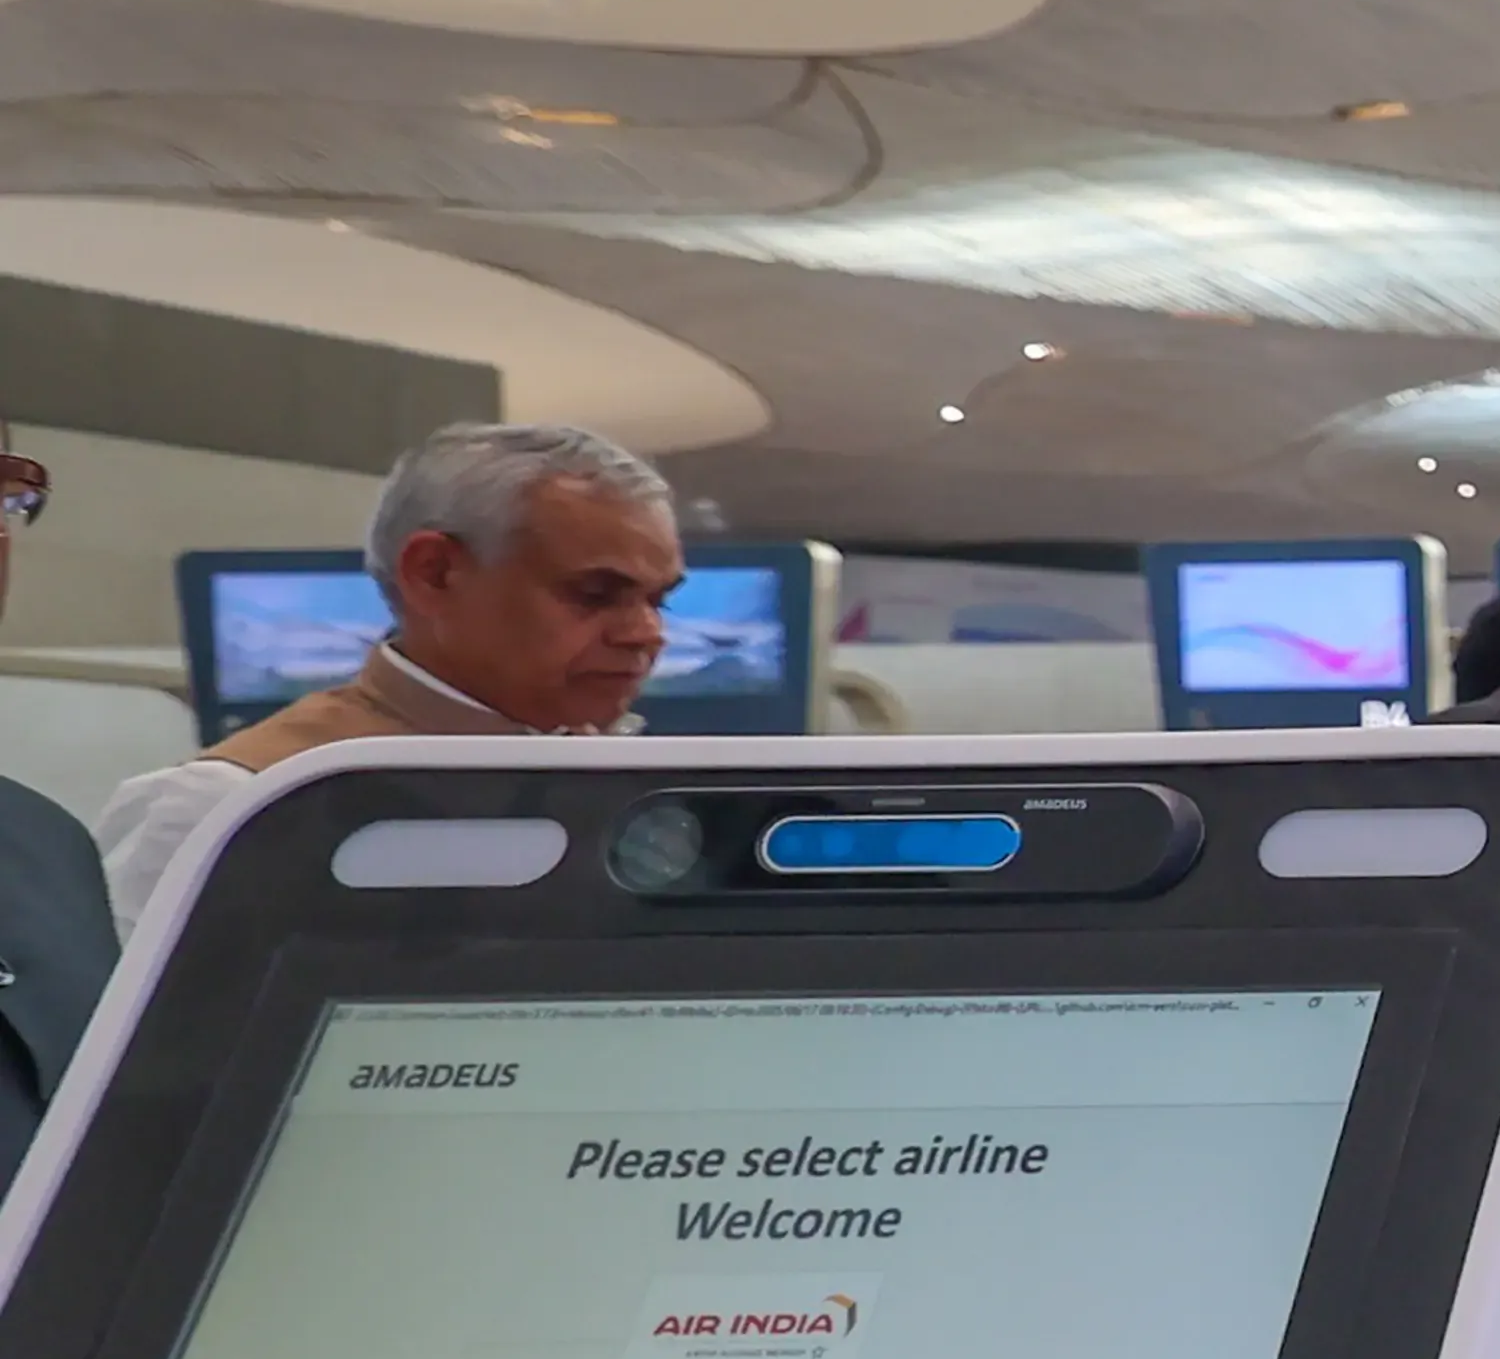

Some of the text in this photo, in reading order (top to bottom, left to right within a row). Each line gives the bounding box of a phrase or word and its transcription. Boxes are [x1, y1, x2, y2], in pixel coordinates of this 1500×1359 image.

[566, 1135, 1048, 1180] Please select airline
[675, 1200, 901, 1242] Welcome
[653, 1313, 833, 1337] AIR INDIA
